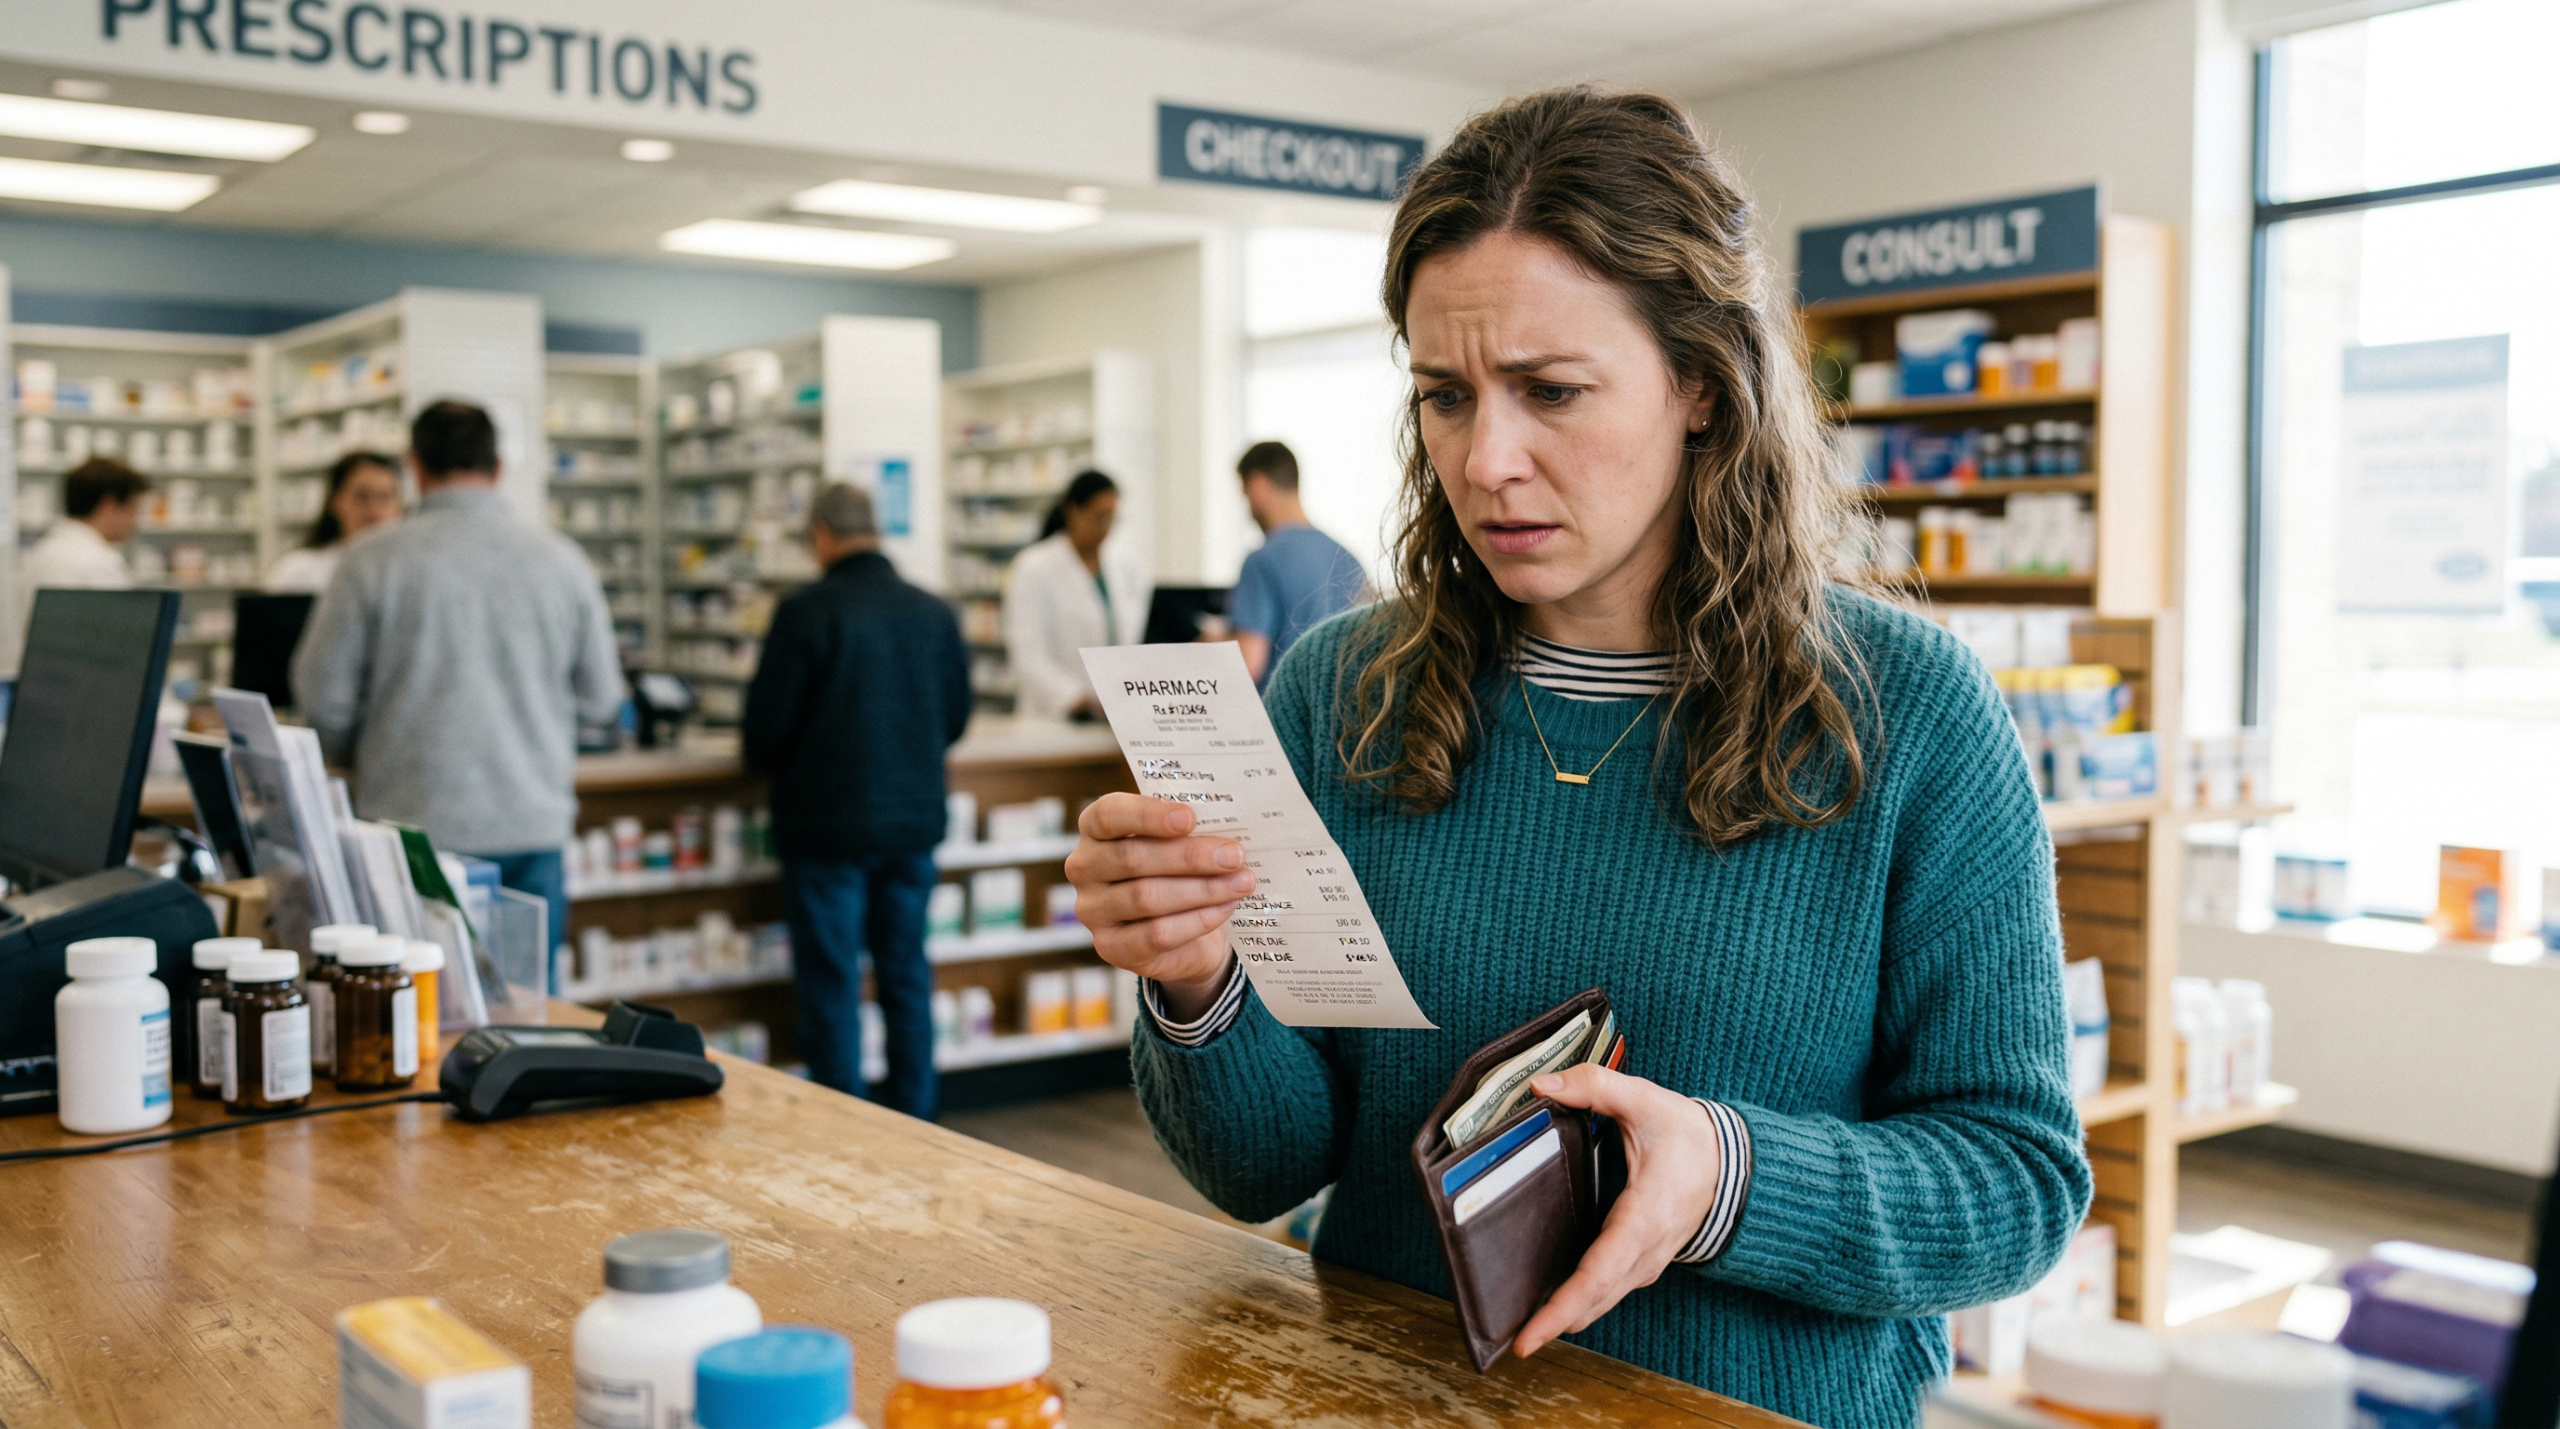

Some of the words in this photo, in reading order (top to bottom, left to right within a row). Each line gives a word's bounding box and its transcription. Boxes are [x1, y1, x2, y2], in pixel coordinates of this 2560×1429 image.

[101, 0, 760, 116] PRESCRIPTIONS
[1184, 118, 1402, 200] CHECKOUT
[1841, 206, 2045, 287] CONSULT
[1124, 679, 1219, 697] PHARMACY
